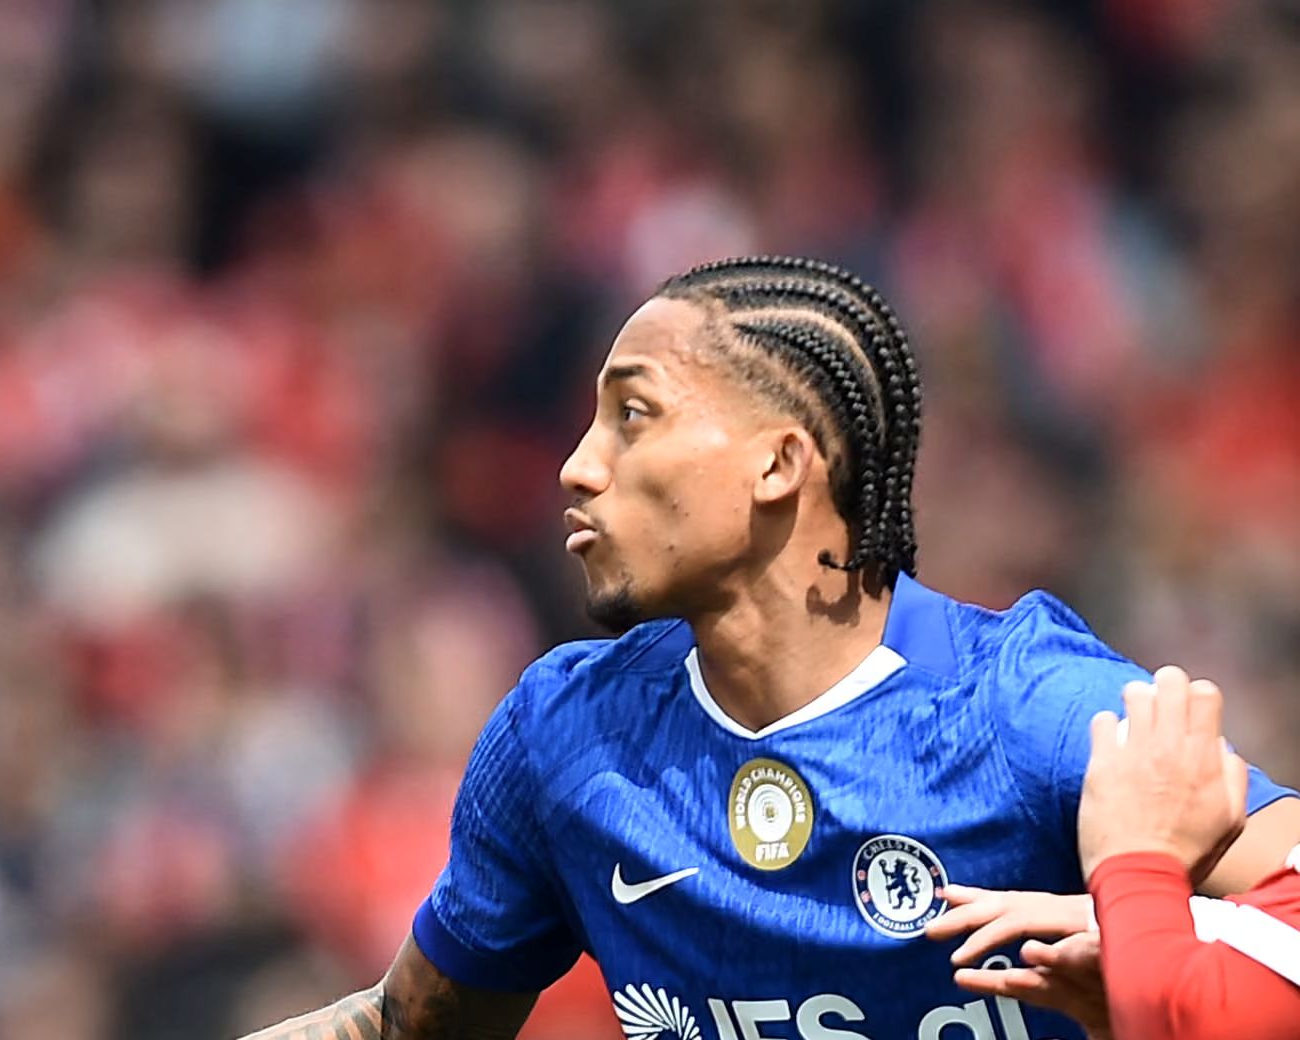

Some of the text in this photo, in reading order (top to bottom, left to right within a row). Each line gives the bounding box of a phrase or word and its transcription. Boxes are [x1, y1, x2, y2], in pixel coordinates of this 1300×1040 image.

[750, 767, 806, 823] CHAMPIONS
[755, 842, 790, 863] FIFA
[863, 840, 922, 860] CHELSEA
